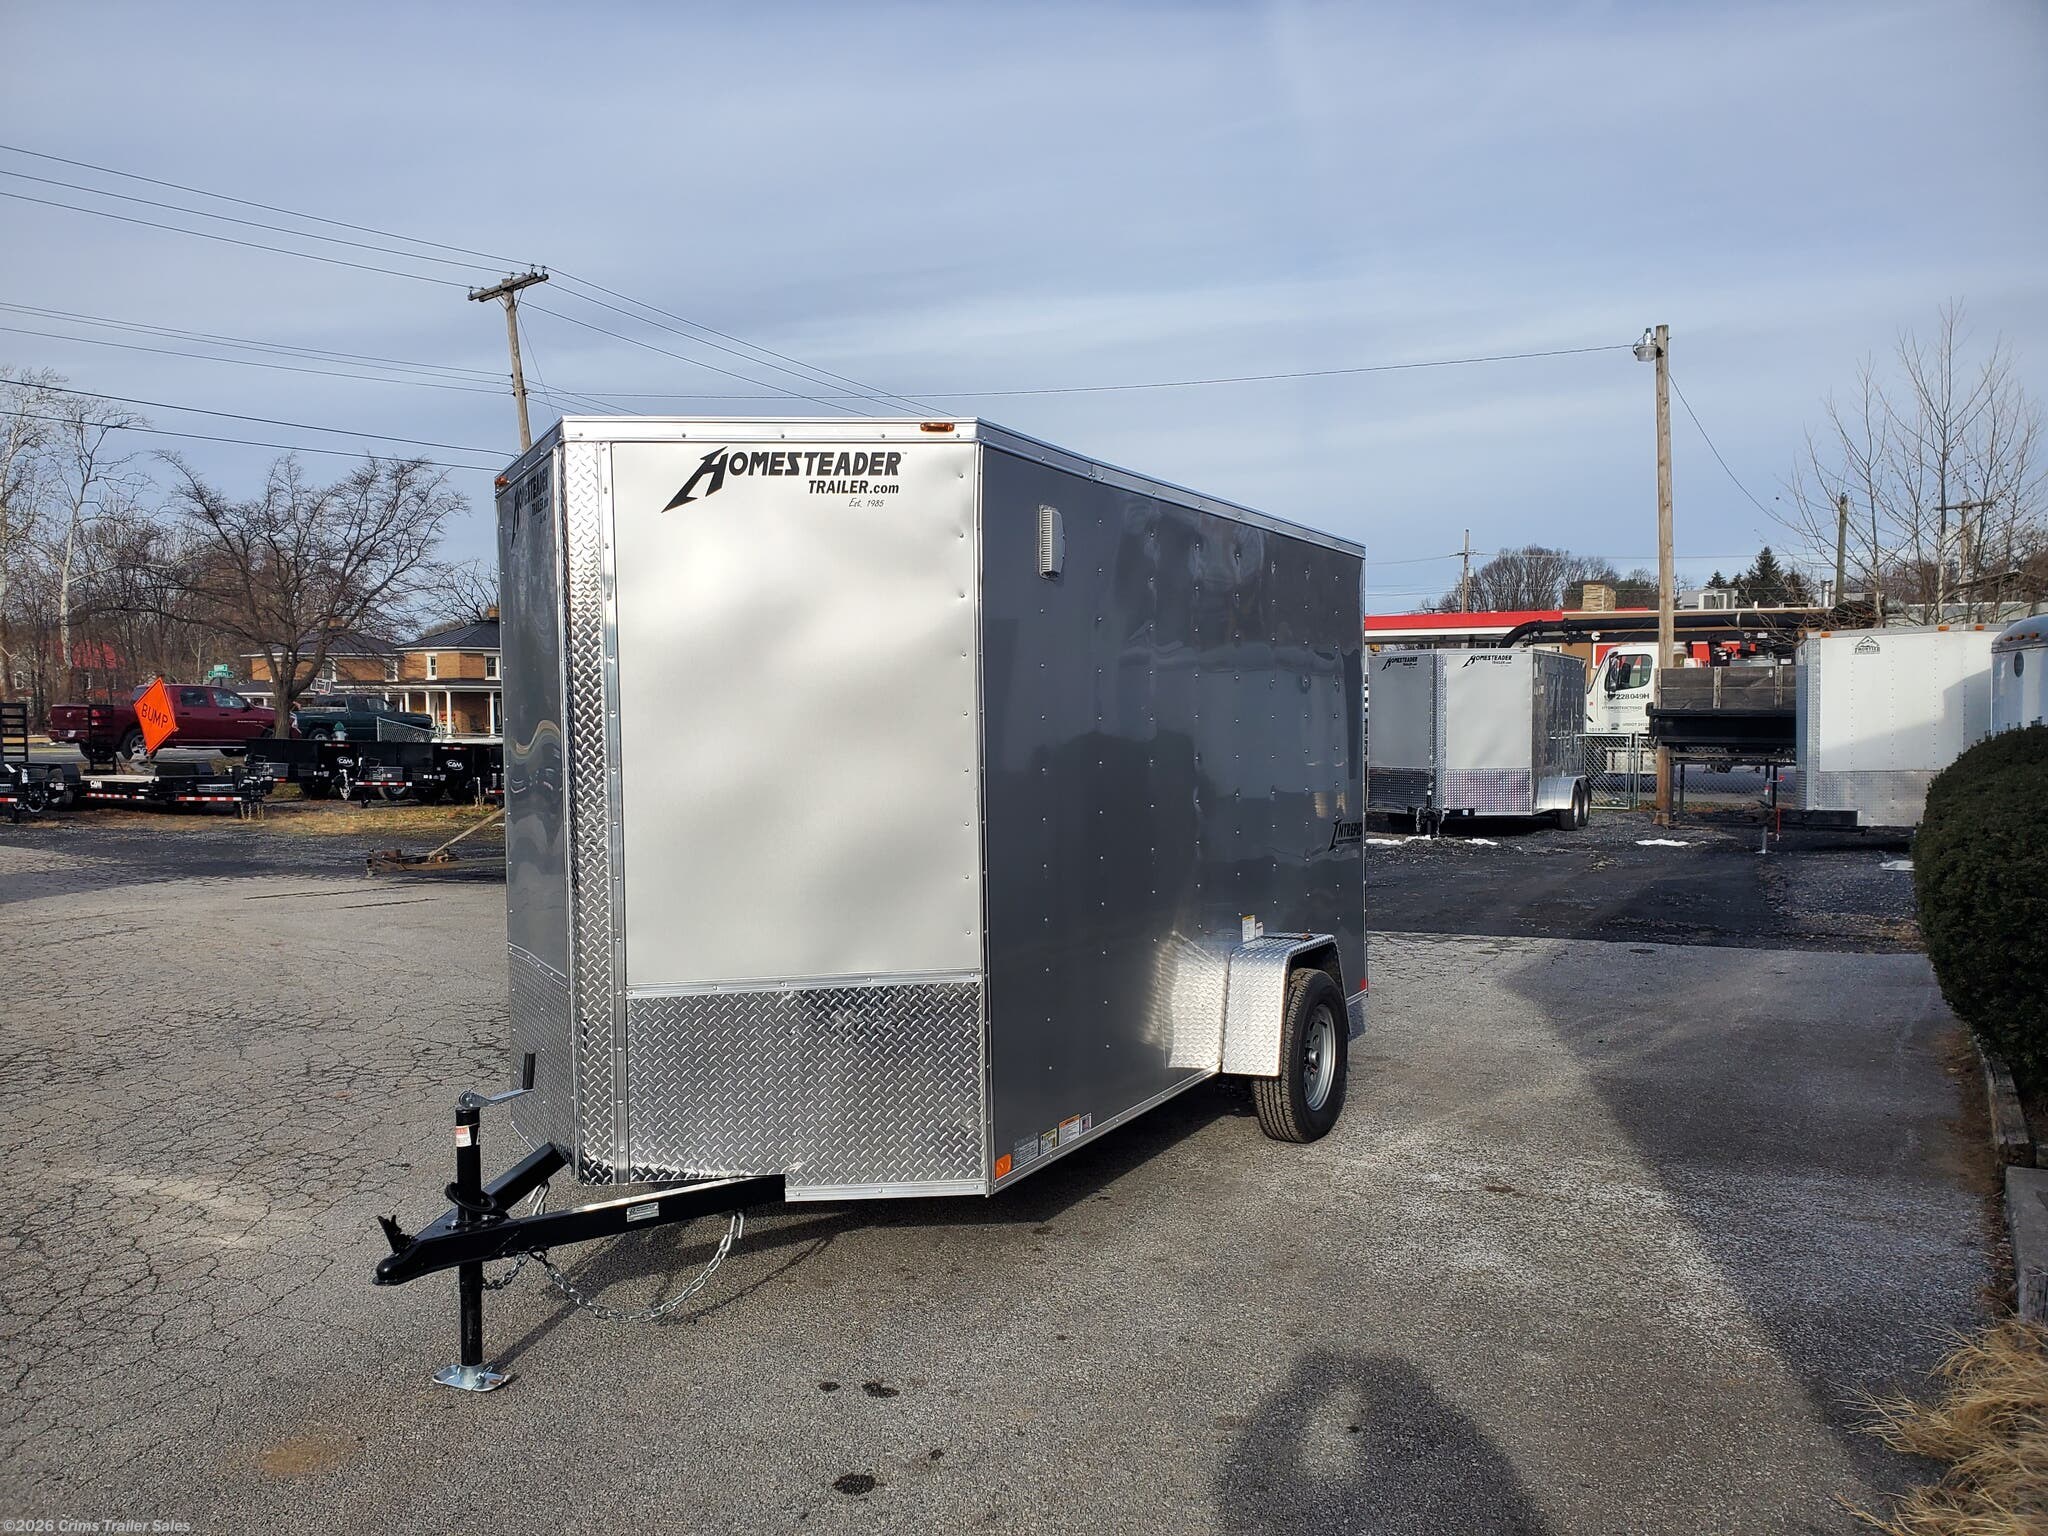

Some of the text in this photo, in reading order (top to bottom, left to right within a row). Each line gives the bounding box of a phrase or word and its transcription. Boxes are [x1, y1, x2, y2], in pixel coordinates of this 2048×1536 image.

[661, 446, 902, 513] HOMESTEADER
[808, 480, 899, 494] TRAILER.com
[848, 497, 885, 508] Est. 1985
[1462, 654, 1512, 668] HOMESTEADER
[141, 703, 169, 728] BUMP
[338, 757, 353, 765] CAM
[447, 761, 462, 769] CAM
[90, 780, 102, 789] CAM
